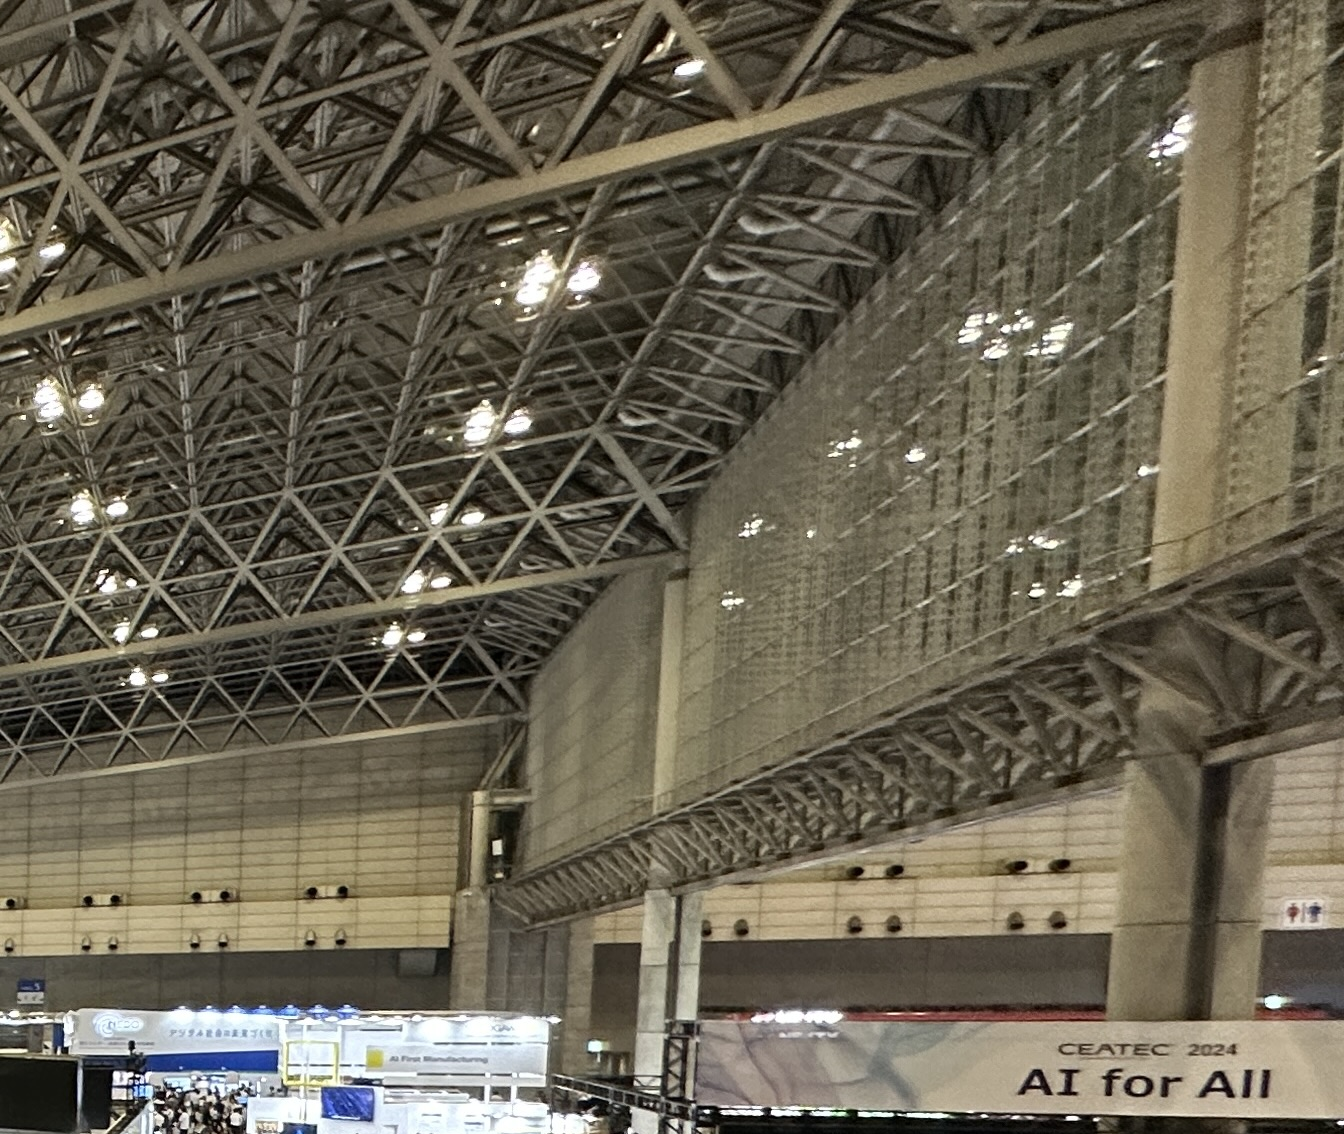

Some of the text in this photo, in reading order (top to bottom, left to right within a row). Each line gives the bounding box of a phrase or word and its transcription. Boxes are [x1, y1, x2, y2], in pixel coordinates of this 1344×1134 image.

[1057, 1043, 1237, 1057] CEATEC 2024
[423, 1055, 489, 1064] Manufacturing
[1017, 1068, 1272, 1099] AI for All
